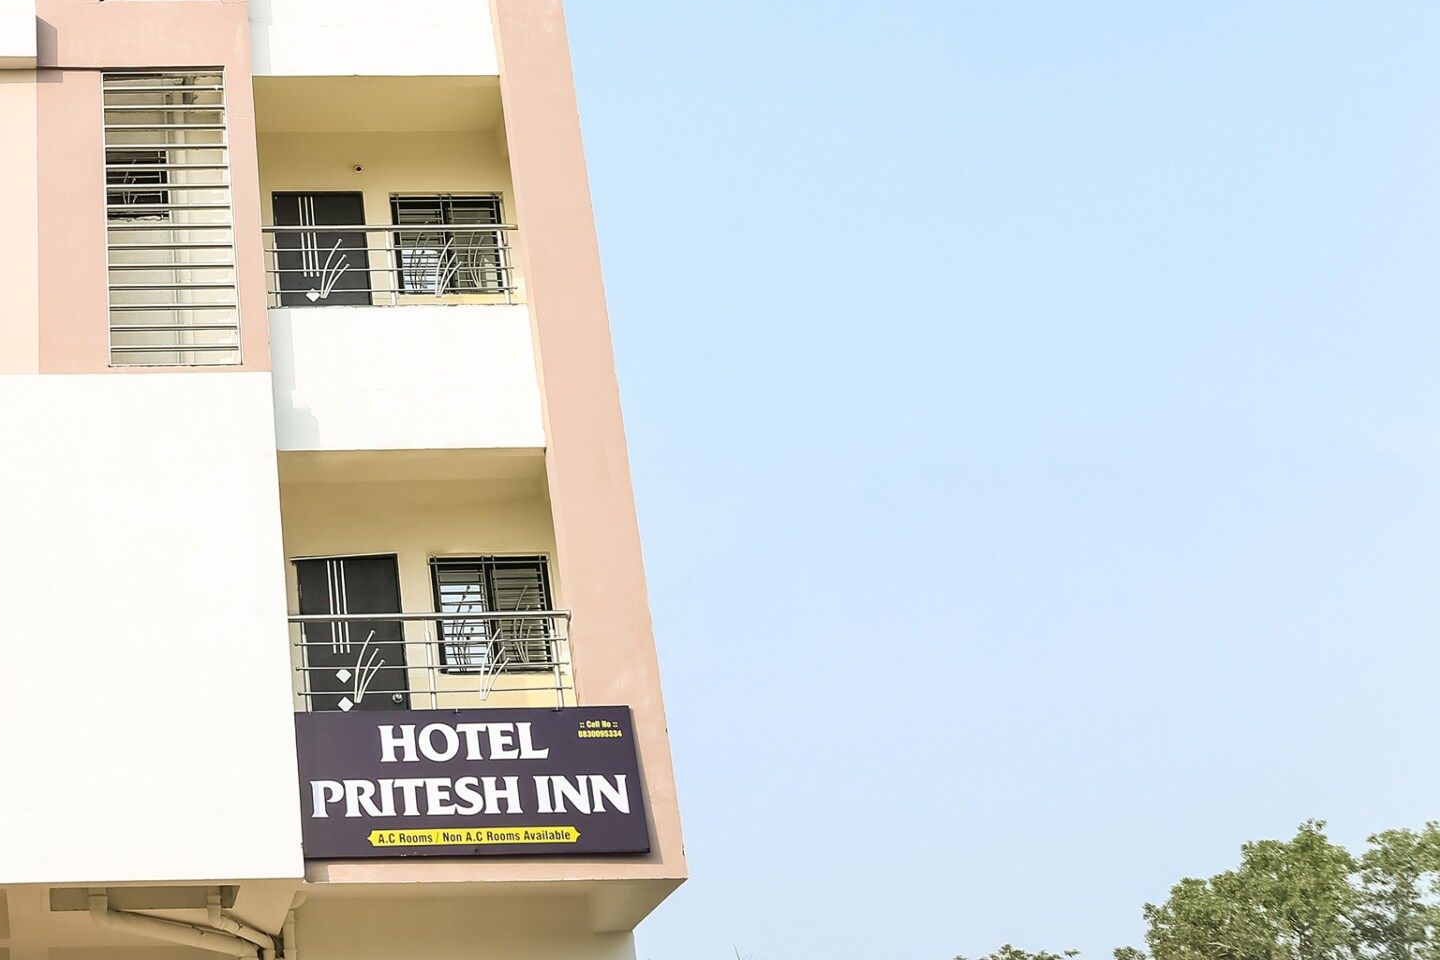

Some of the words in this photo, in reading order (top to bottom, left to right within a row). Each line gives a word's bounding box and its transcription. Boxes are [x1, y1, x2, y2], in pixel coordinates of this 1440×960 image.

[586, 720, 601, 728] Cell
[378, 722, 550, 763] HOTEL
[310, 776, 523, 818] PRITESH
[532, 774, 631, 815] INN
[378, 833, 396, 844] A.C
[399, 832, 433, 843] Rooms
[442, 831, 462, 842] Non
[465, 830, 484, 841] A.C
[486, 829, 521, 841] Rooms
[523, 828, 571, 840] Available
